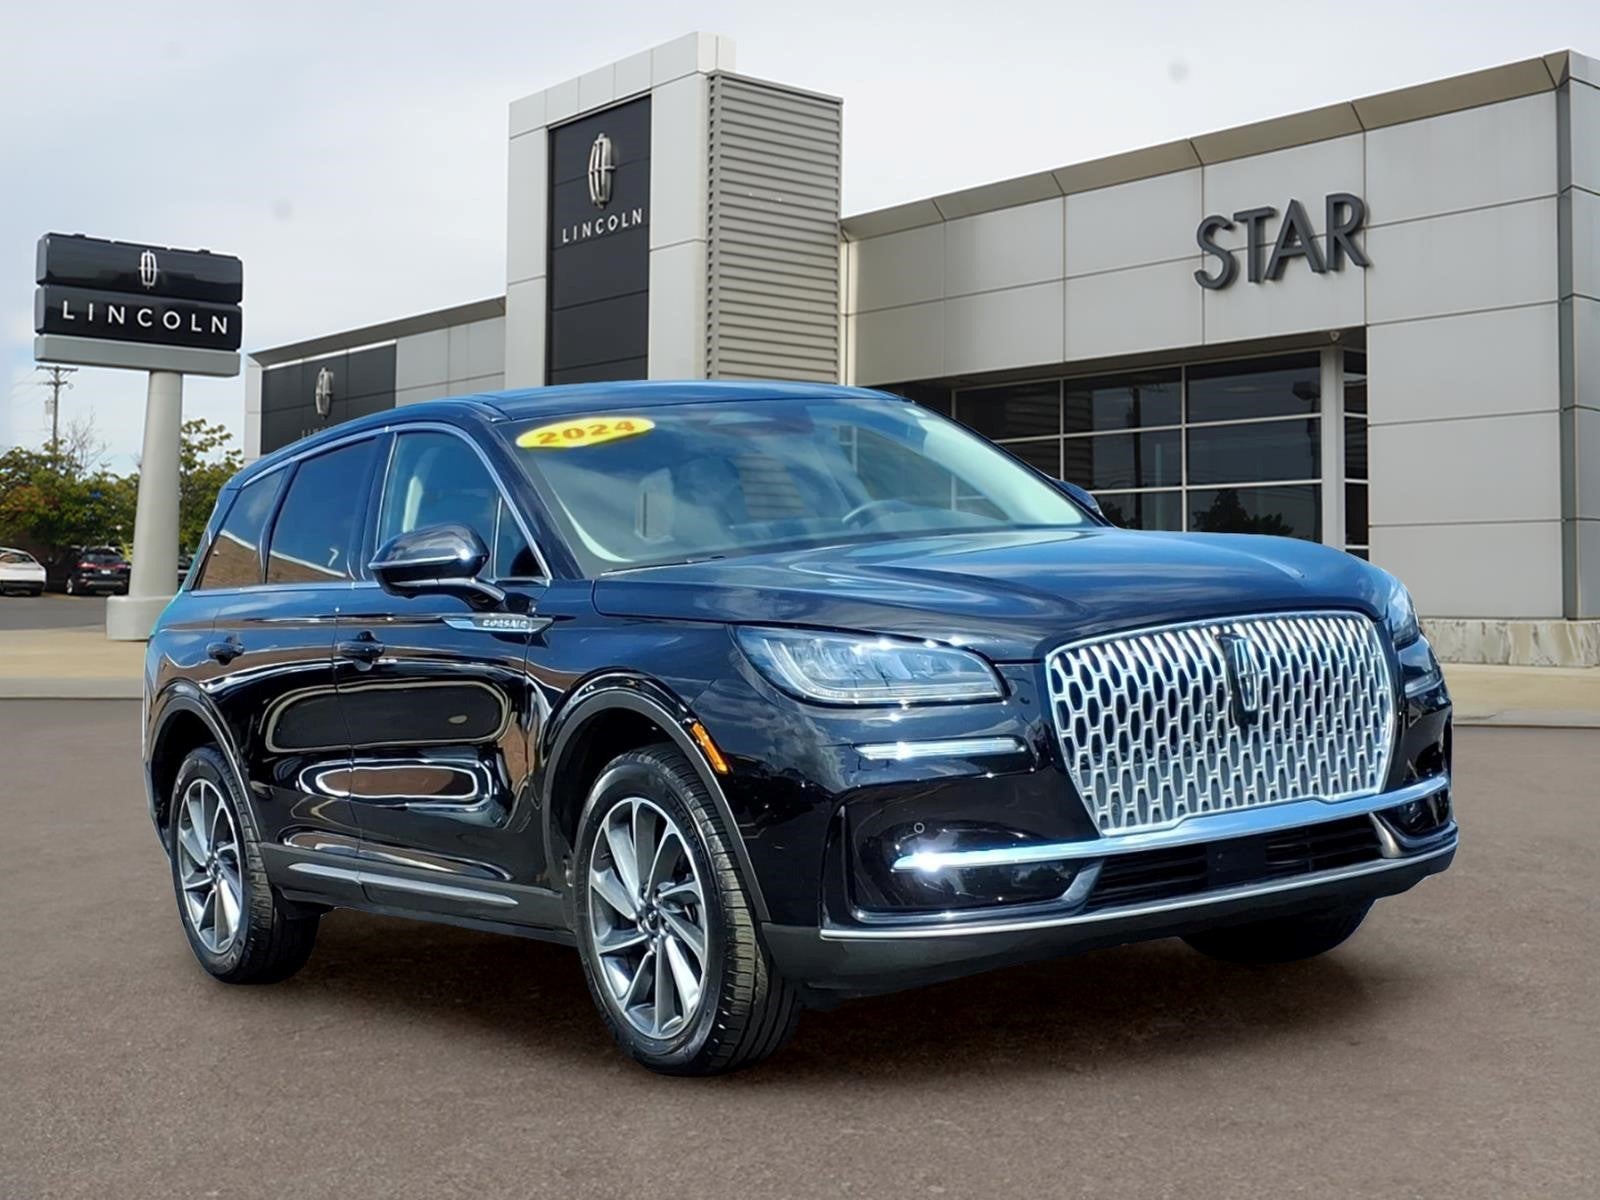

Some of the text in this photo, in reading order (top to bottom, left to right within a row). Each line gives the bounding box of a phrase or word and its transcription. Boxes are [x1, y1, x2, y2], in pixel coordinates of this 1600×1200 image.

[562, 208, 643, 243] LINCOLN
[1193, 192, 1370, 290] STAR
[62, 300, 228, 335] LINCOLN
[536, 420, 636, 445] 2024
